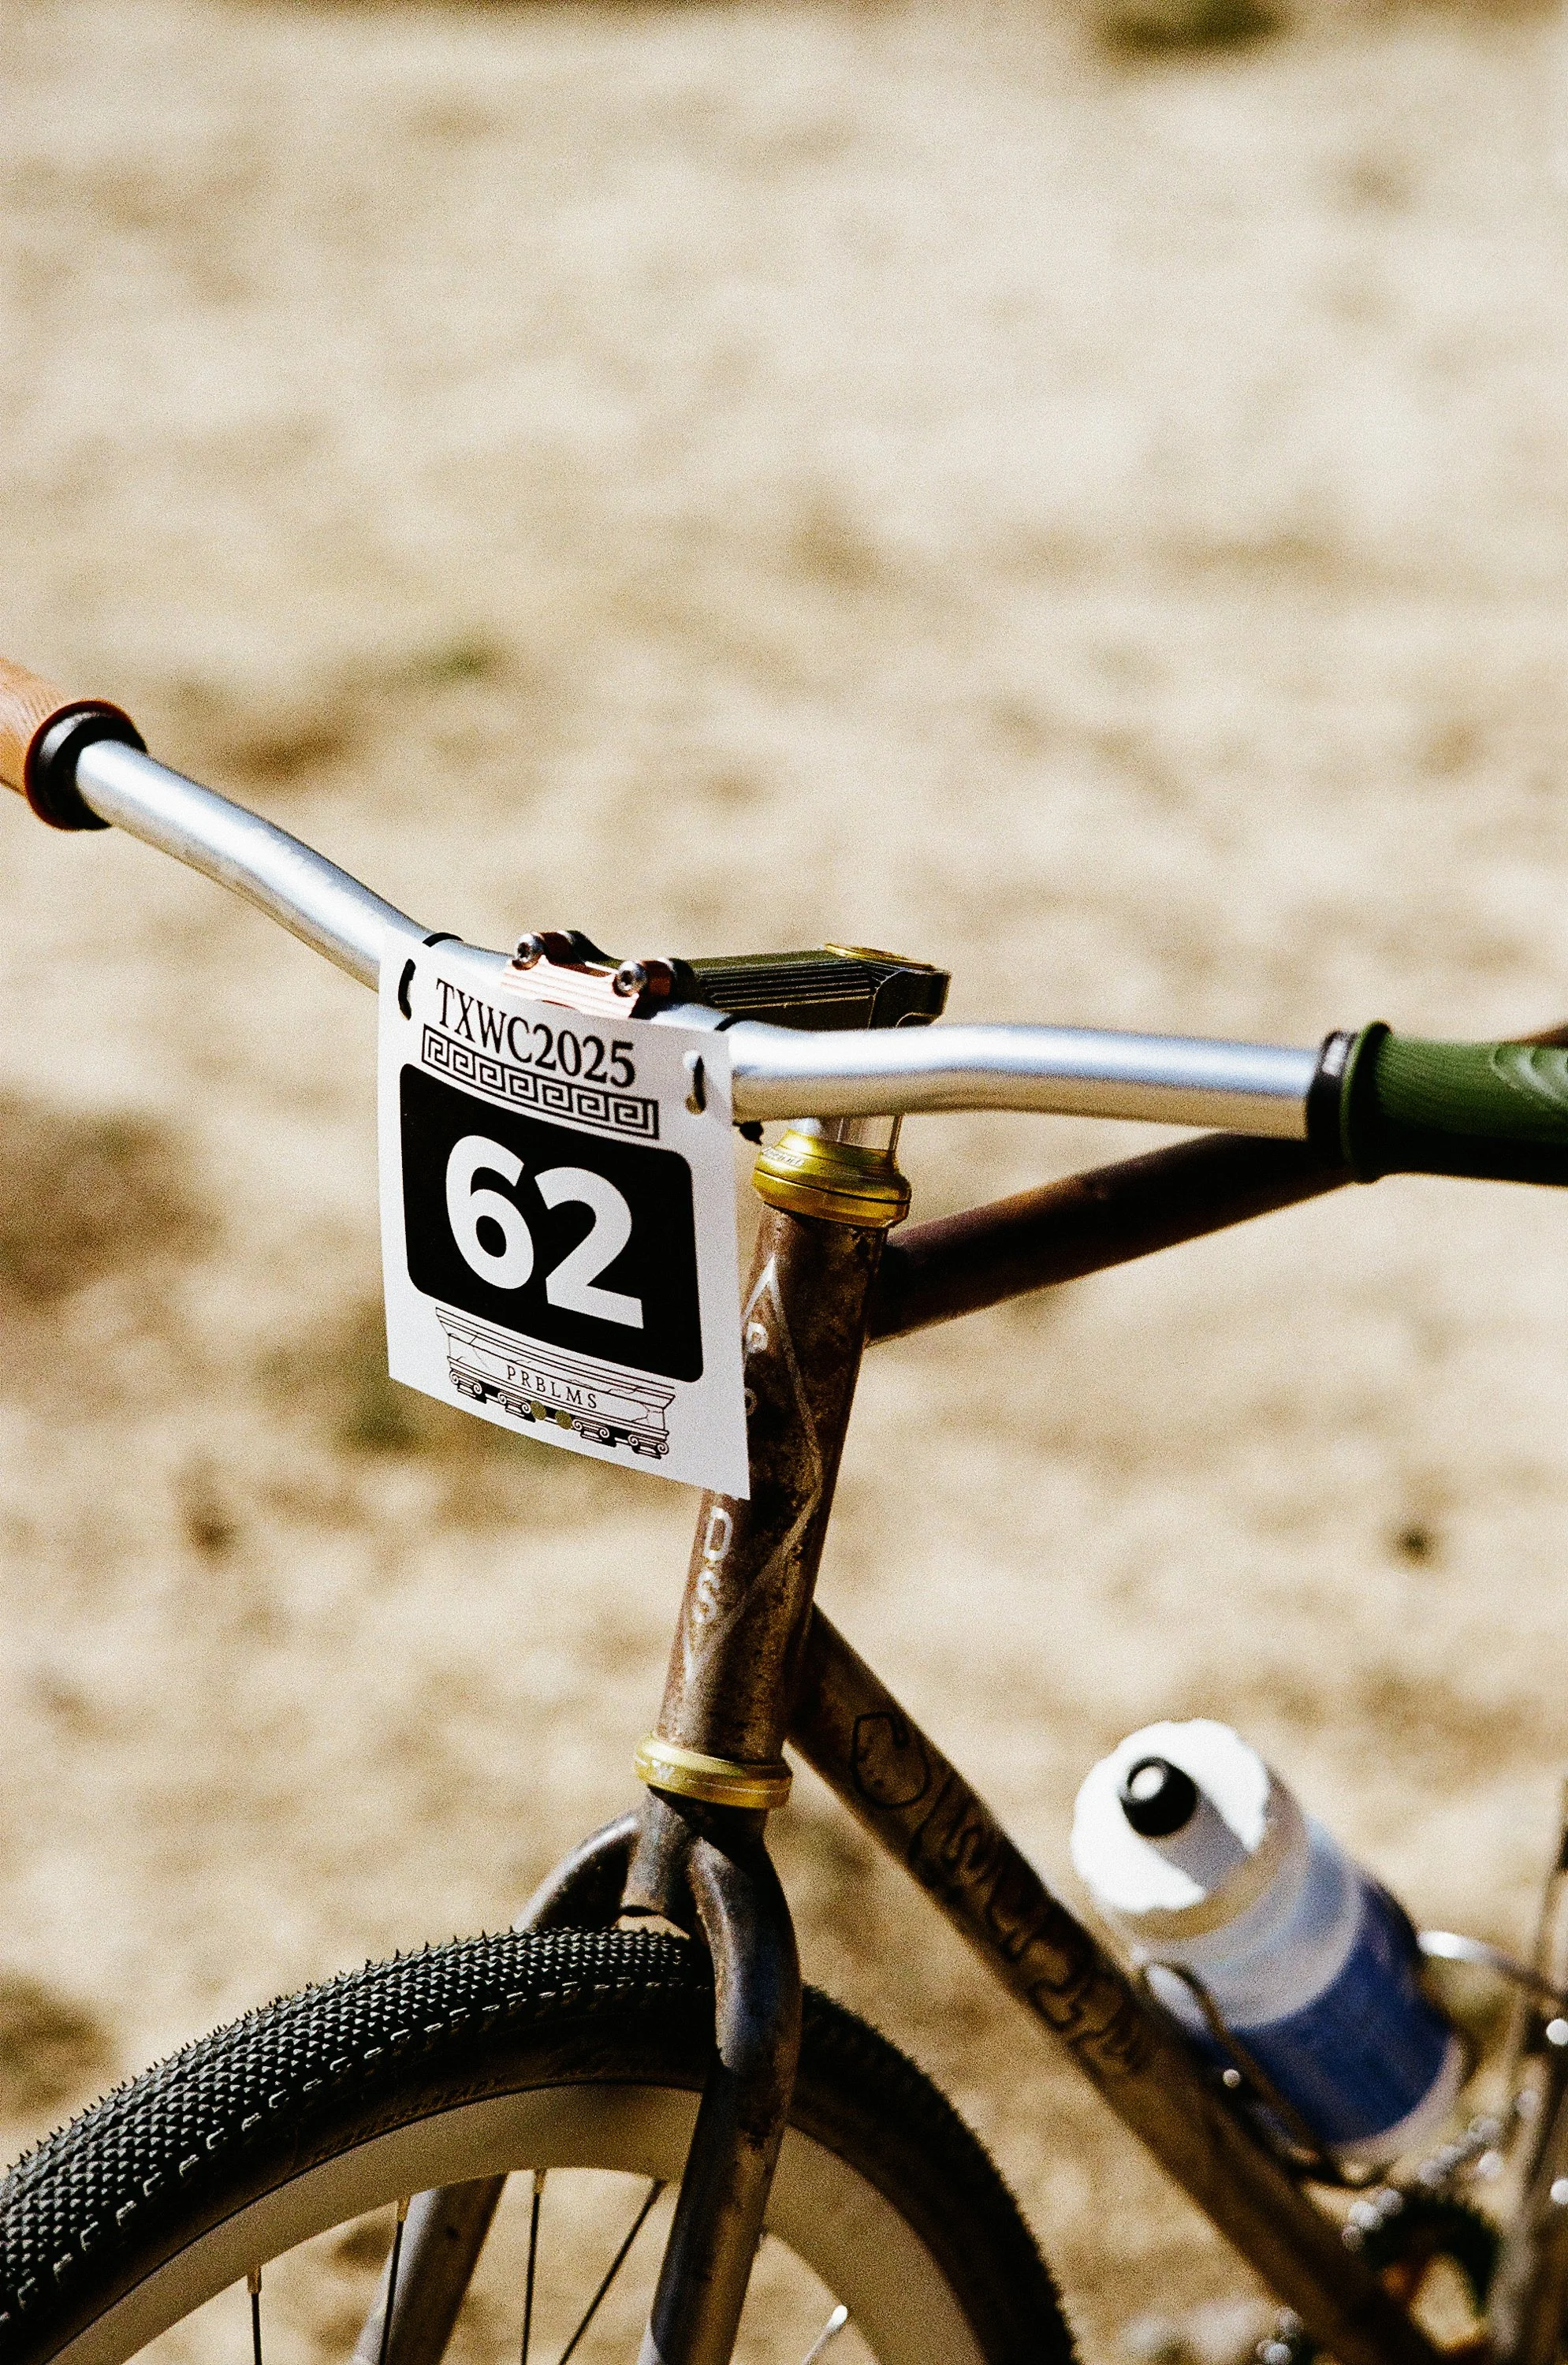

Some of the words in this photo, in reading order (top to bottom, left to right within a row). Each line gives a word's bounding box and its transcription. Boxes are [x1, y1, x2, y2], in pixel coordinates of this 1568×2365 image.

[436, 978, 636, 1088] TXWC2025
[445, 1134, 644, 1329] 62
[507, 1365, 597, 1409] PRBLMS
